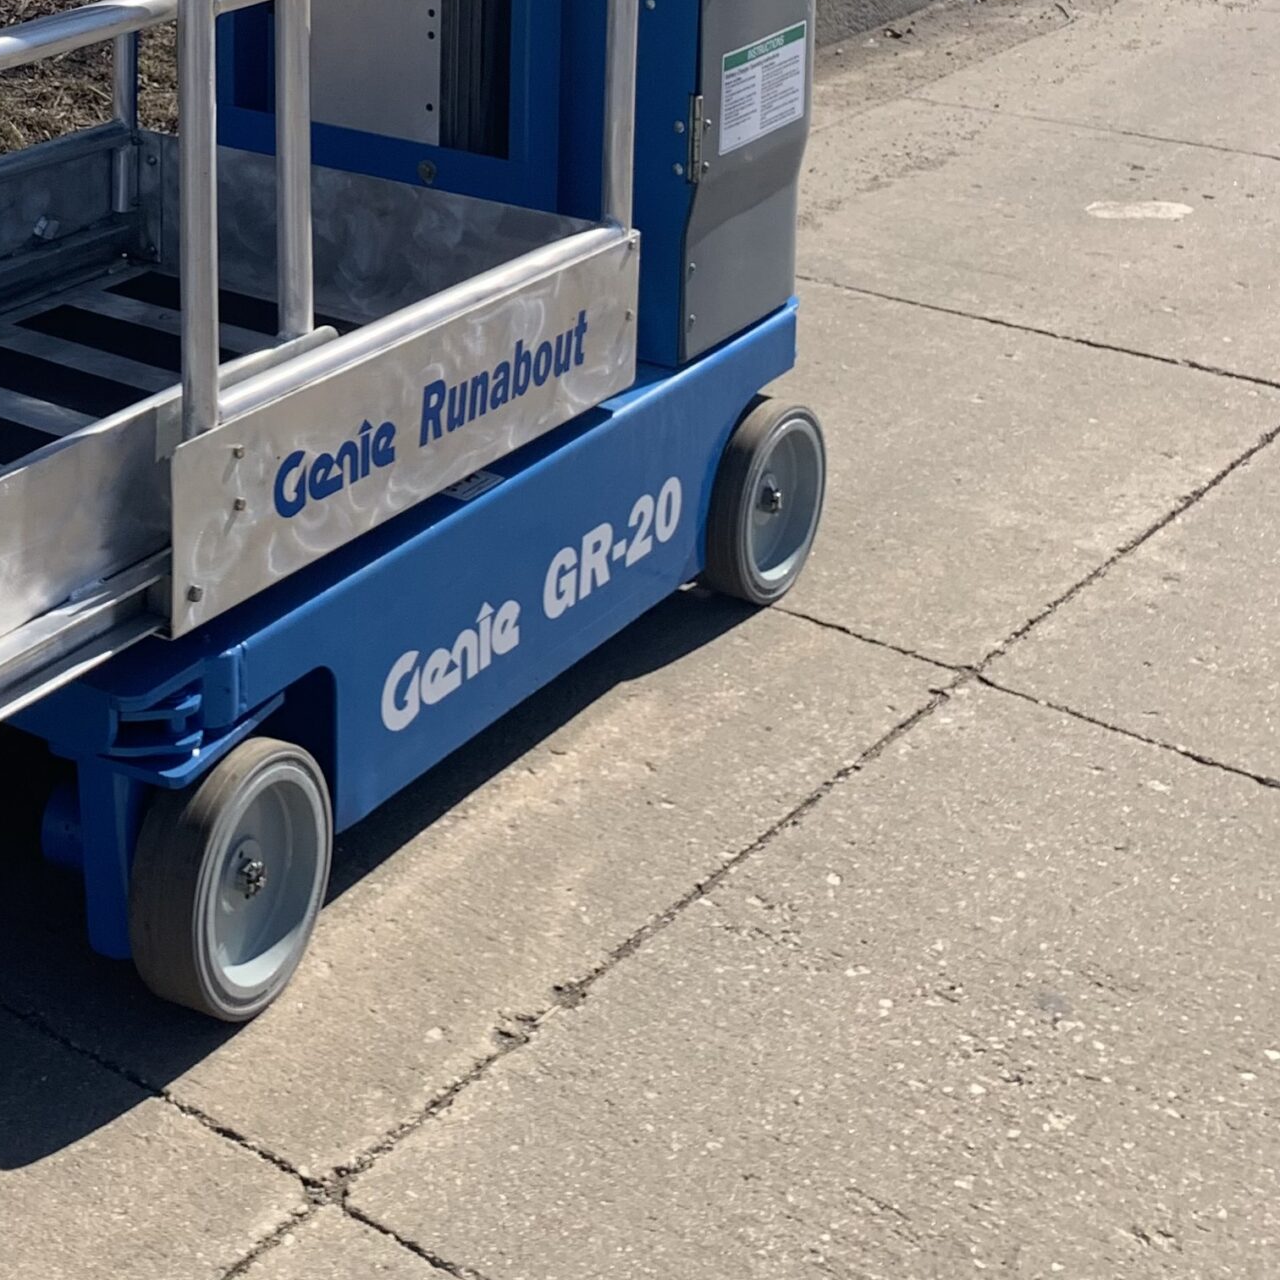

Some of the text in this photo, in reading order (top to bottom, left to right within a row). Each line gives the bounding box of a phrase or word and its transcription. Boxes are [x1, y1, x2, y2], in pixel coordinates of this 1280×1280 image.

[274, 310, 588, 519] Genie Runabout
[381, 476, 682, 732] Genie GR-20
